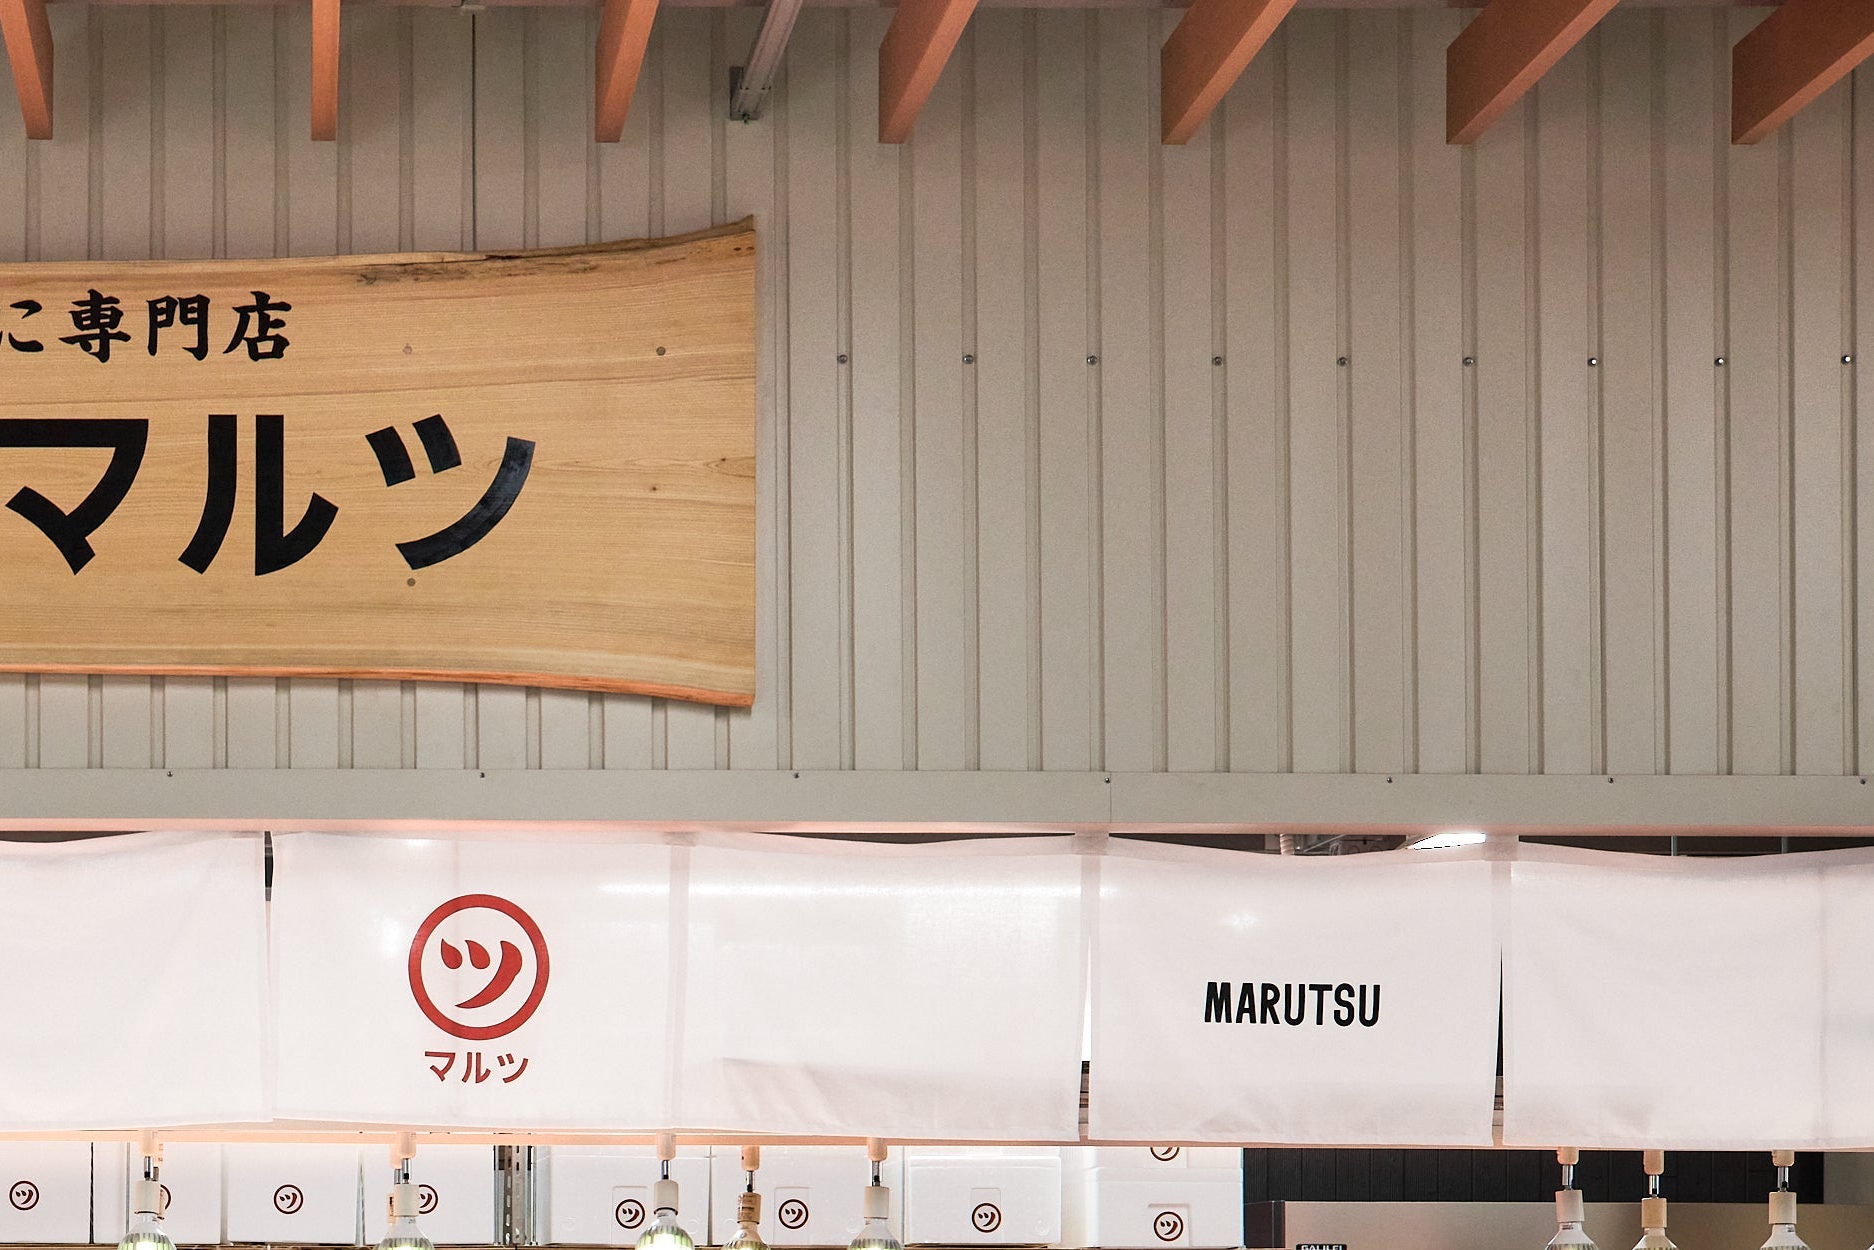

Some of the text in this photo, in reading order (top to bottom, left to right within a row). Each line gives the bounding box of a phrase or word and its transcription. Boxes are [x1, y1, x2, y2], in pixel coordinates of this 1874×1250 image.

[1204, 981, 1381, 1028] MARUTSU
[424, 1049, 530, 1085] マルツ
